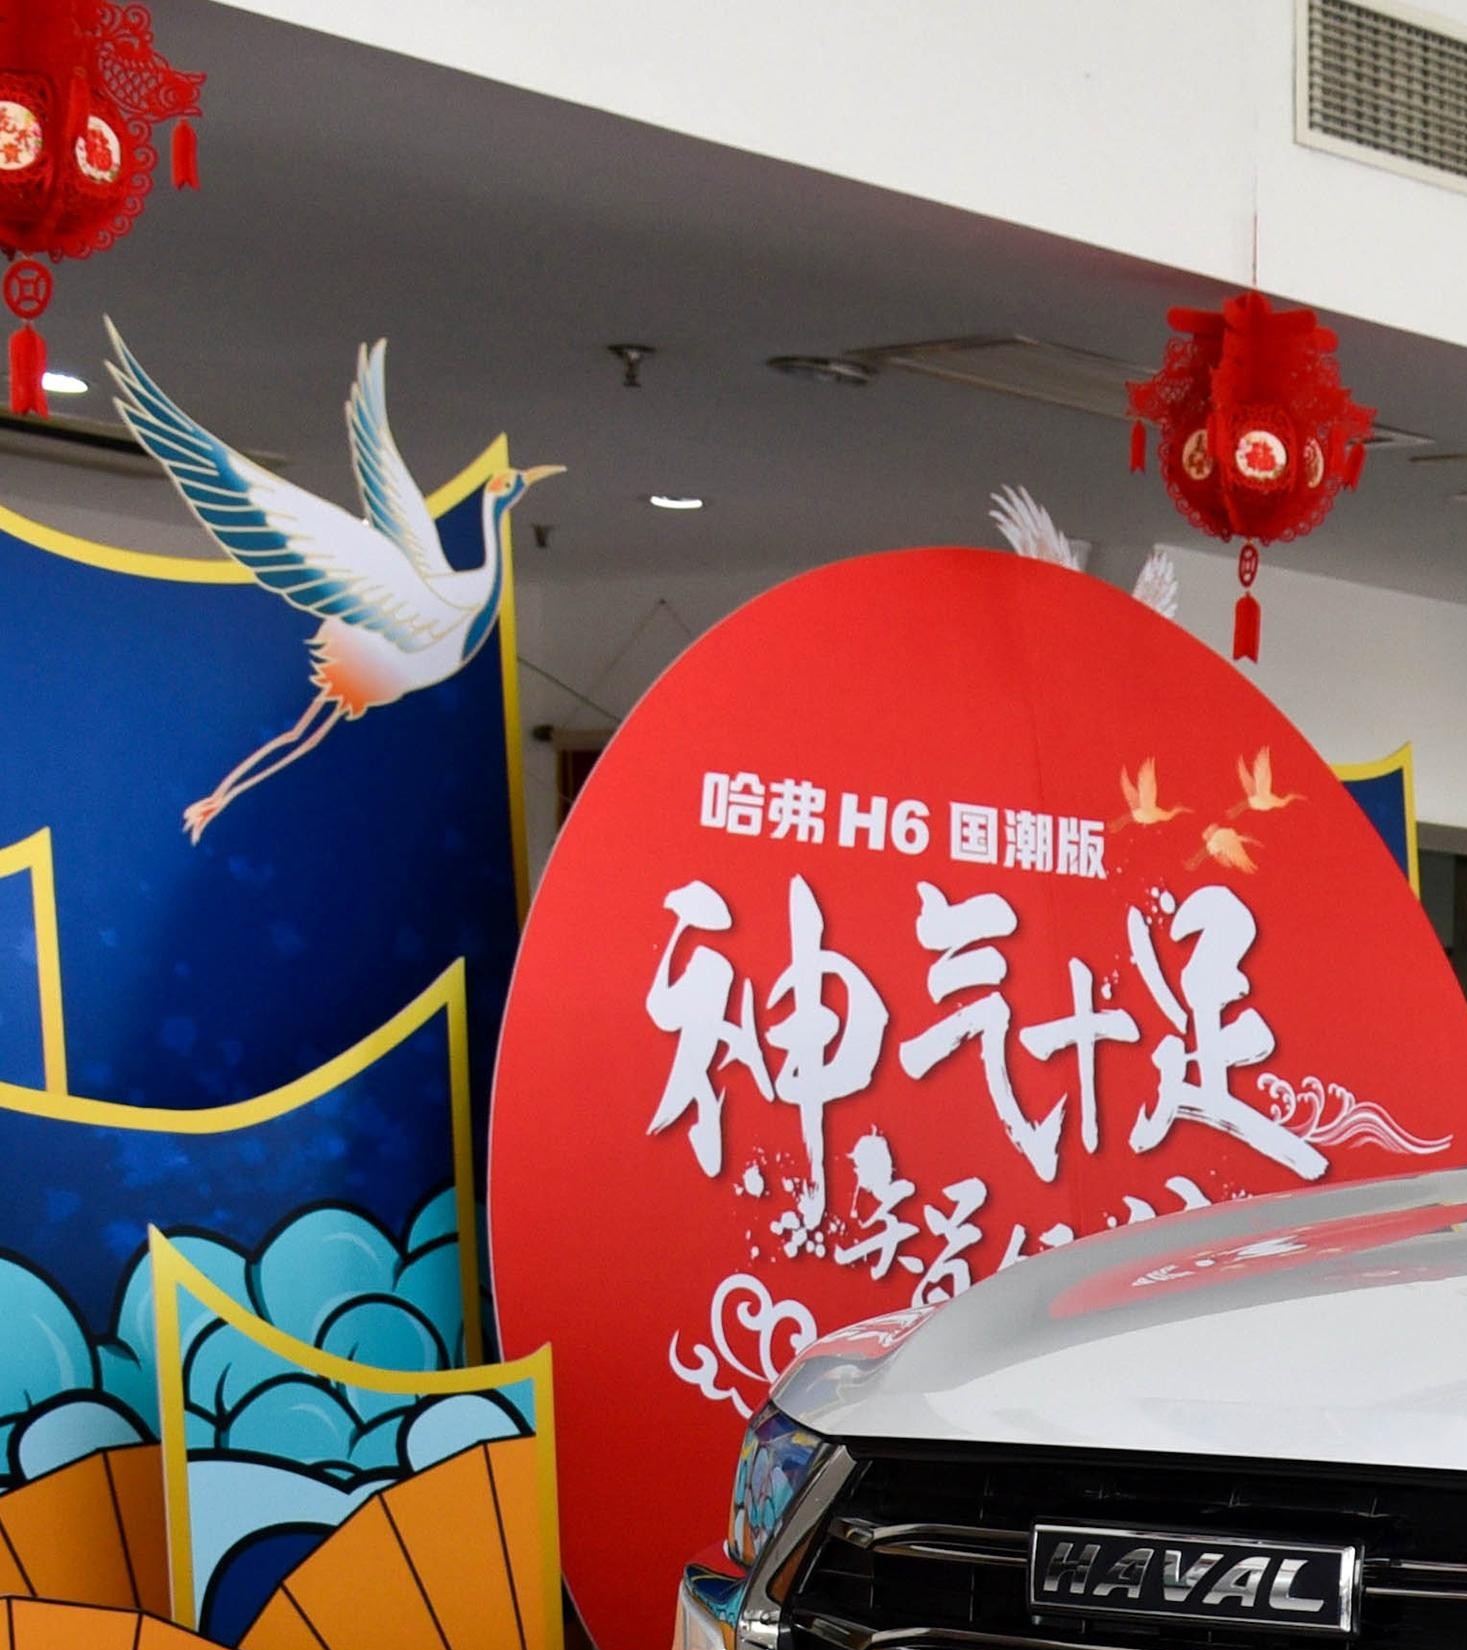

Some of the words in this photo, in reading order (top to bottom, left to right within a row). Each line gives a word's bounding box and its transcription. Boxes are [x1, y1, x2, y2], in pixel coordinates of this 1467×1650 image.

[700, 771, 826, 845] 哈弗
[837, 794, 931, 856] H6
[949, 803, 1108, 881] 国潮版
[645, 875, 1328, 1226] 神气十足
[1042, 1541, 1326, 1614] HAVAL
